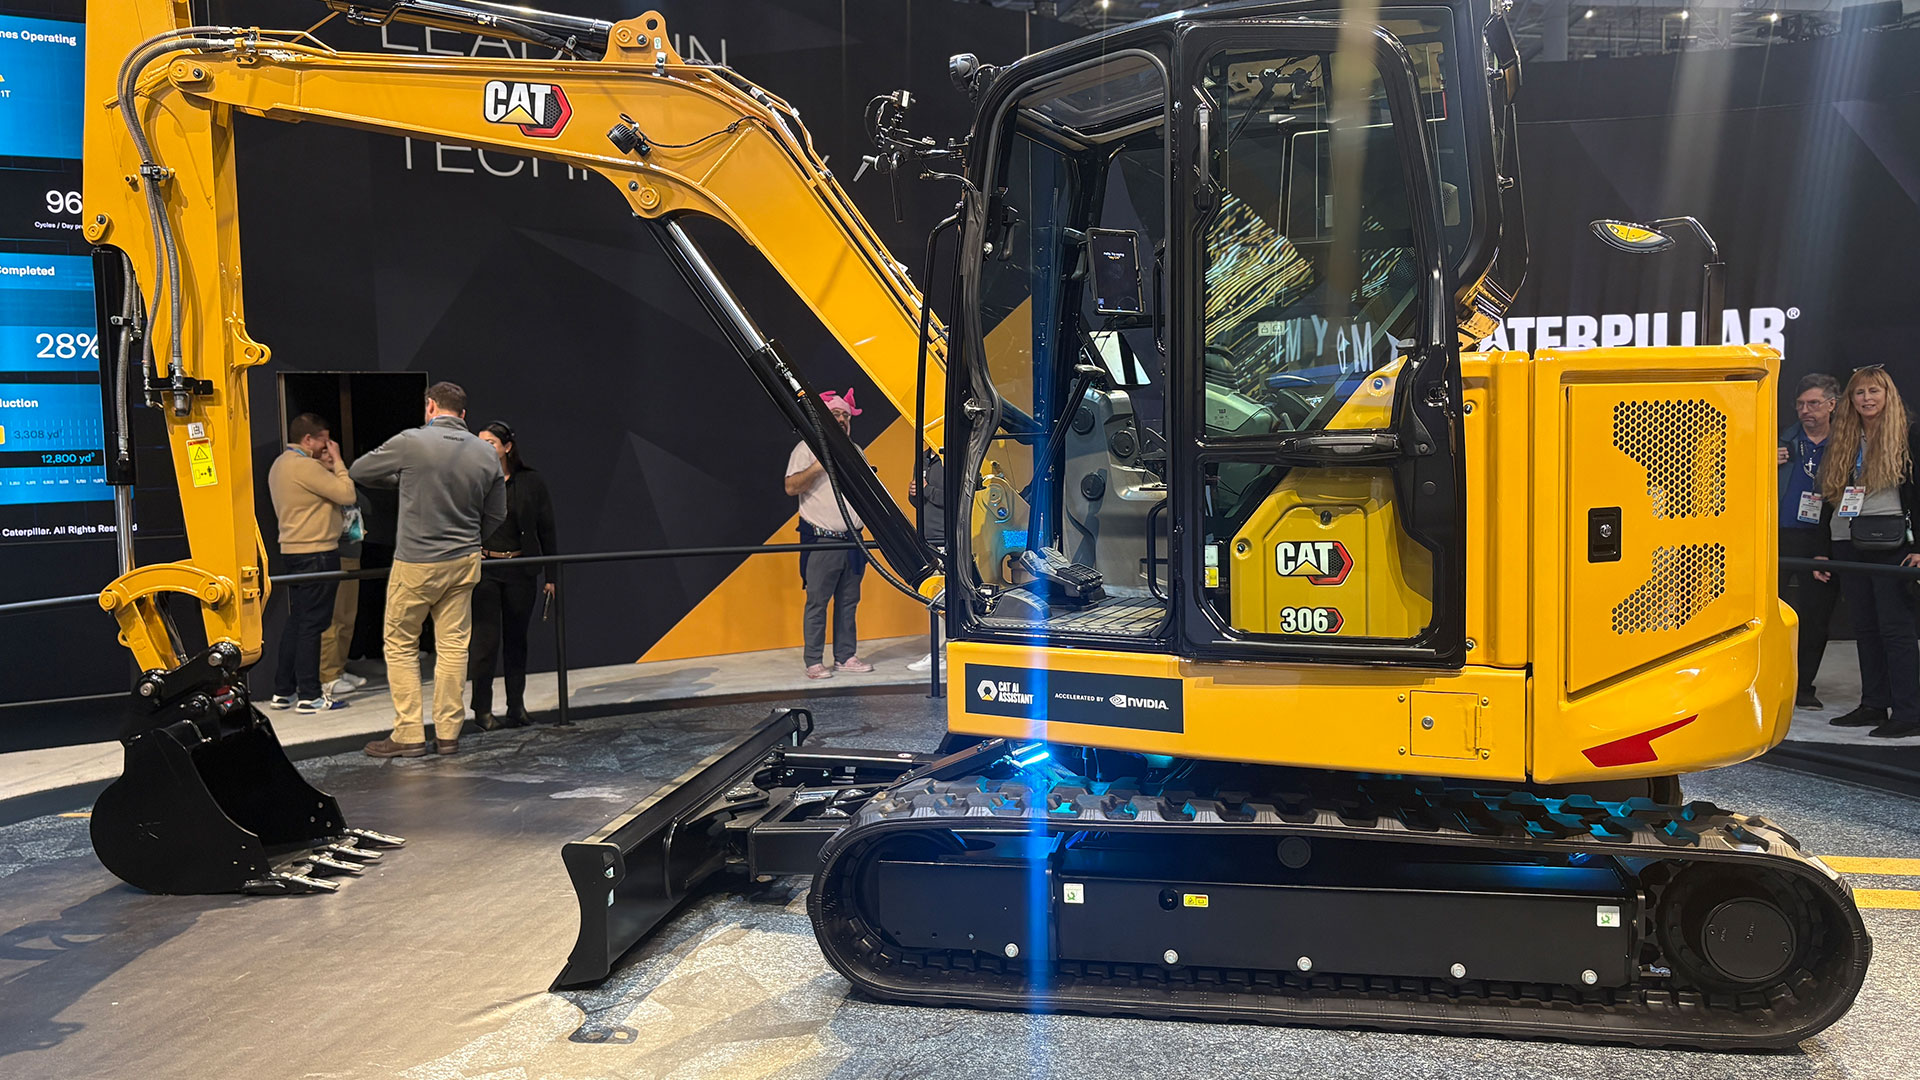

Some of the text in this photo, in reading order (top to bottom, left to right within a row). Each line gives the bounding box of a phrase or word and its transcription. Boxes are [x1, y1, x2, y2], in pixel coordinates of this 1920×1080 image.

[20, 30, 77, 46] Operating
[485, 80, 552, 125] CAT
[34, 221, 56, 229] Cycles
[61, 222, 73, 230] Day
[1479, 307, 1800, 360] ATERPILLAR®
[35, 333, 100, 359] 28%
[0, 398, 39, 408] uction
[14, 430, 44, 440] 3,308
[41, 454, 77, 464] 12,800
[2, 527, 52, 537] Caterpillar.
[53, 526, 66, 535] All
[68, 525, 96, 536] Rights
[1276, 542, 1334, 575] CAT
[1280, 608, 1329, 632] 306
[998, 681, 1020, 693] CAT AI
[998, 691, 1034, 705] ASSISTANT
[1055, 693, 1095, 702] ACCELERATED
